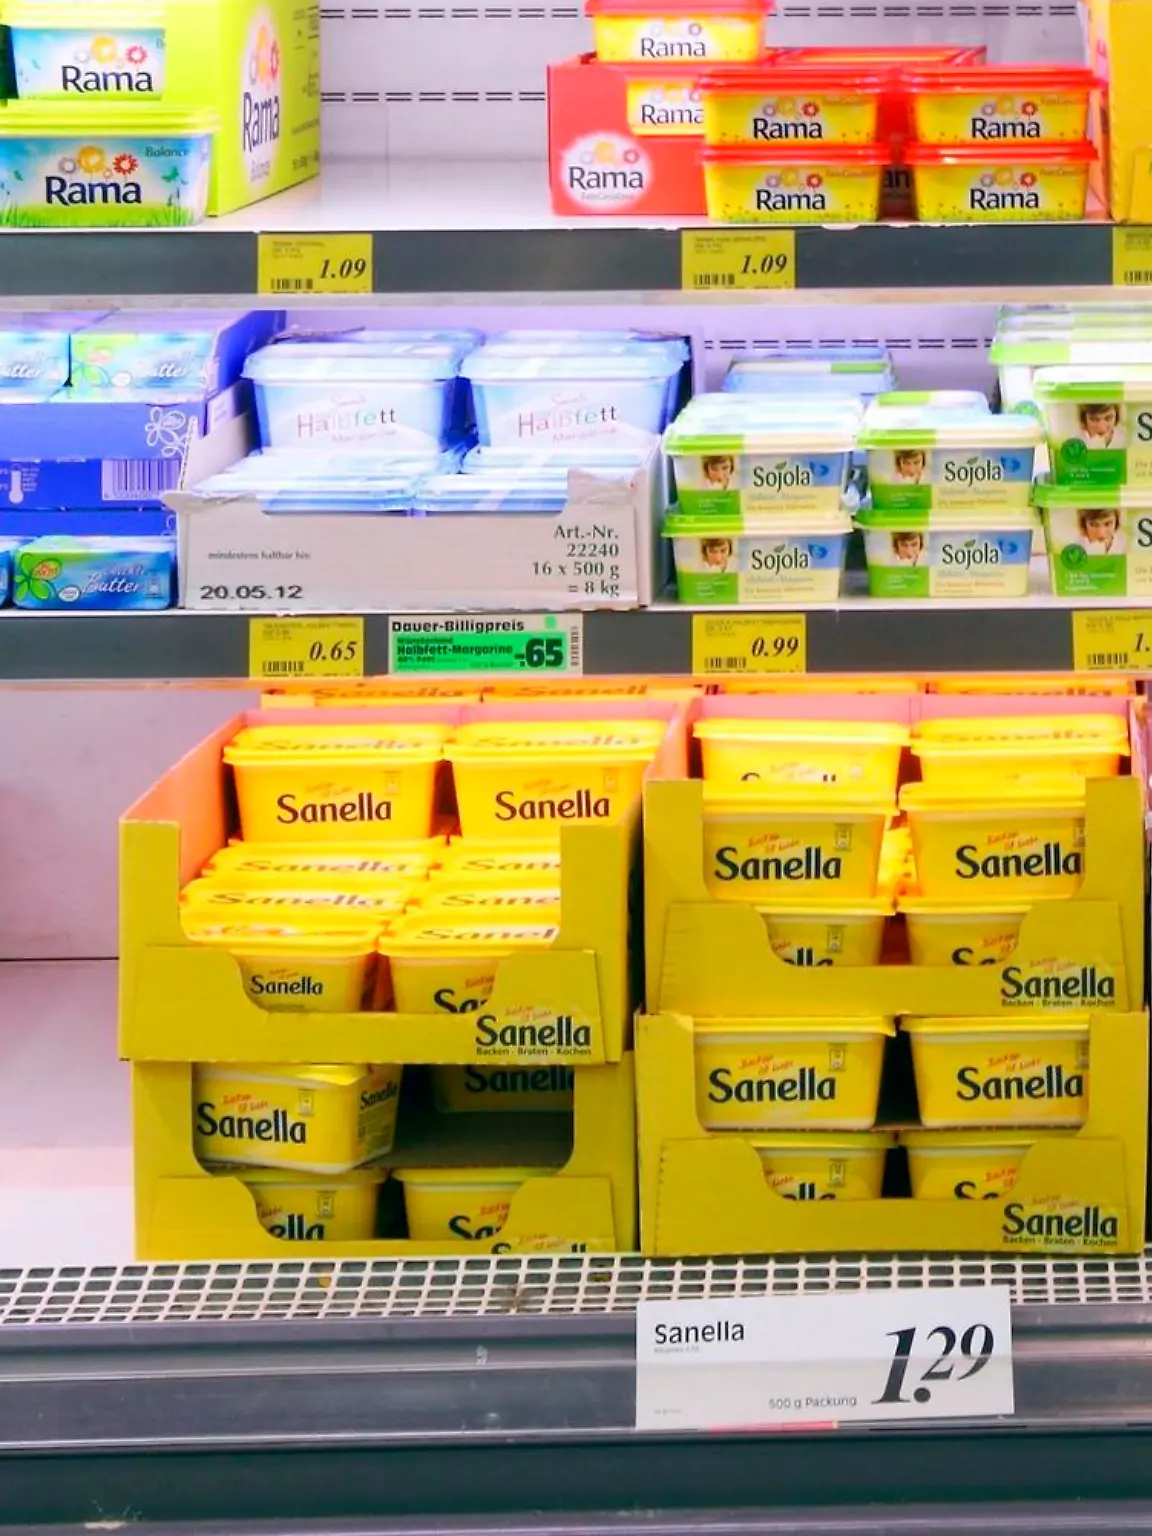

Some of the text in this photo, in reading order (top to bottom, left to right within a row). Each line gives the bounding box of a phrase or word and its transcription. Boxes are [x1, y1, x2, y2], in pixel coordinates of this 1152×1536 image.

[62, 64, 154, 94] Rama
[753, 117, 823, 141] Rama
[145, 145, 190, 158] Balance
[568, 165, 644, 191] Rama
[46, 175, 142, 206] Rama
[755, 188, 826, 212] Rama
[970, 187, 1040, 211] Rama
[319, 259, 366, 279] 1.09
[741, 254, 787, 274] 1.09
[517, 405, 618, 437] Halbfett
[752, 465, 811, 492] Sojola
[944, 460, 1001, 487] Sojola
[554, 523, 619, 541] Art.-Nr.
[567, 543, 620, 558] 22240
[751, 547, 809, 574] Sojola
[942, 543, 999, 570] Sojola
[532, 561, 620, 579] 16 x 500 g
[199, 584, 303, 600] 20.05.12
[585, 579, 620, 598] 8 kg
[391, 620, 525, 634] Dauer-Billigpreis
[309, 640, 358, 662] 0.65
[397, 645, 513, 656] Halbfett-Margarine
[751, 636, 799, 658] 0.99
[714, 845, 842, 881] Sanella
[1001, 966, 1116, 1000] Sanella
[475, 1015, 592, 1047] Sanella
[708, 1067, 837, 1104] Sanella
[956, 1064, 1084, 1101] Sanella
[196, 1102, 307, 1145] Sanella
[1002, 1203, 1118, 1239] Sanella
[653, 1320, 745, 1344] Sanella
[870, 1323, 995, 1405] 1.29
[768, 1394, 858, 1411] 500 Packung
